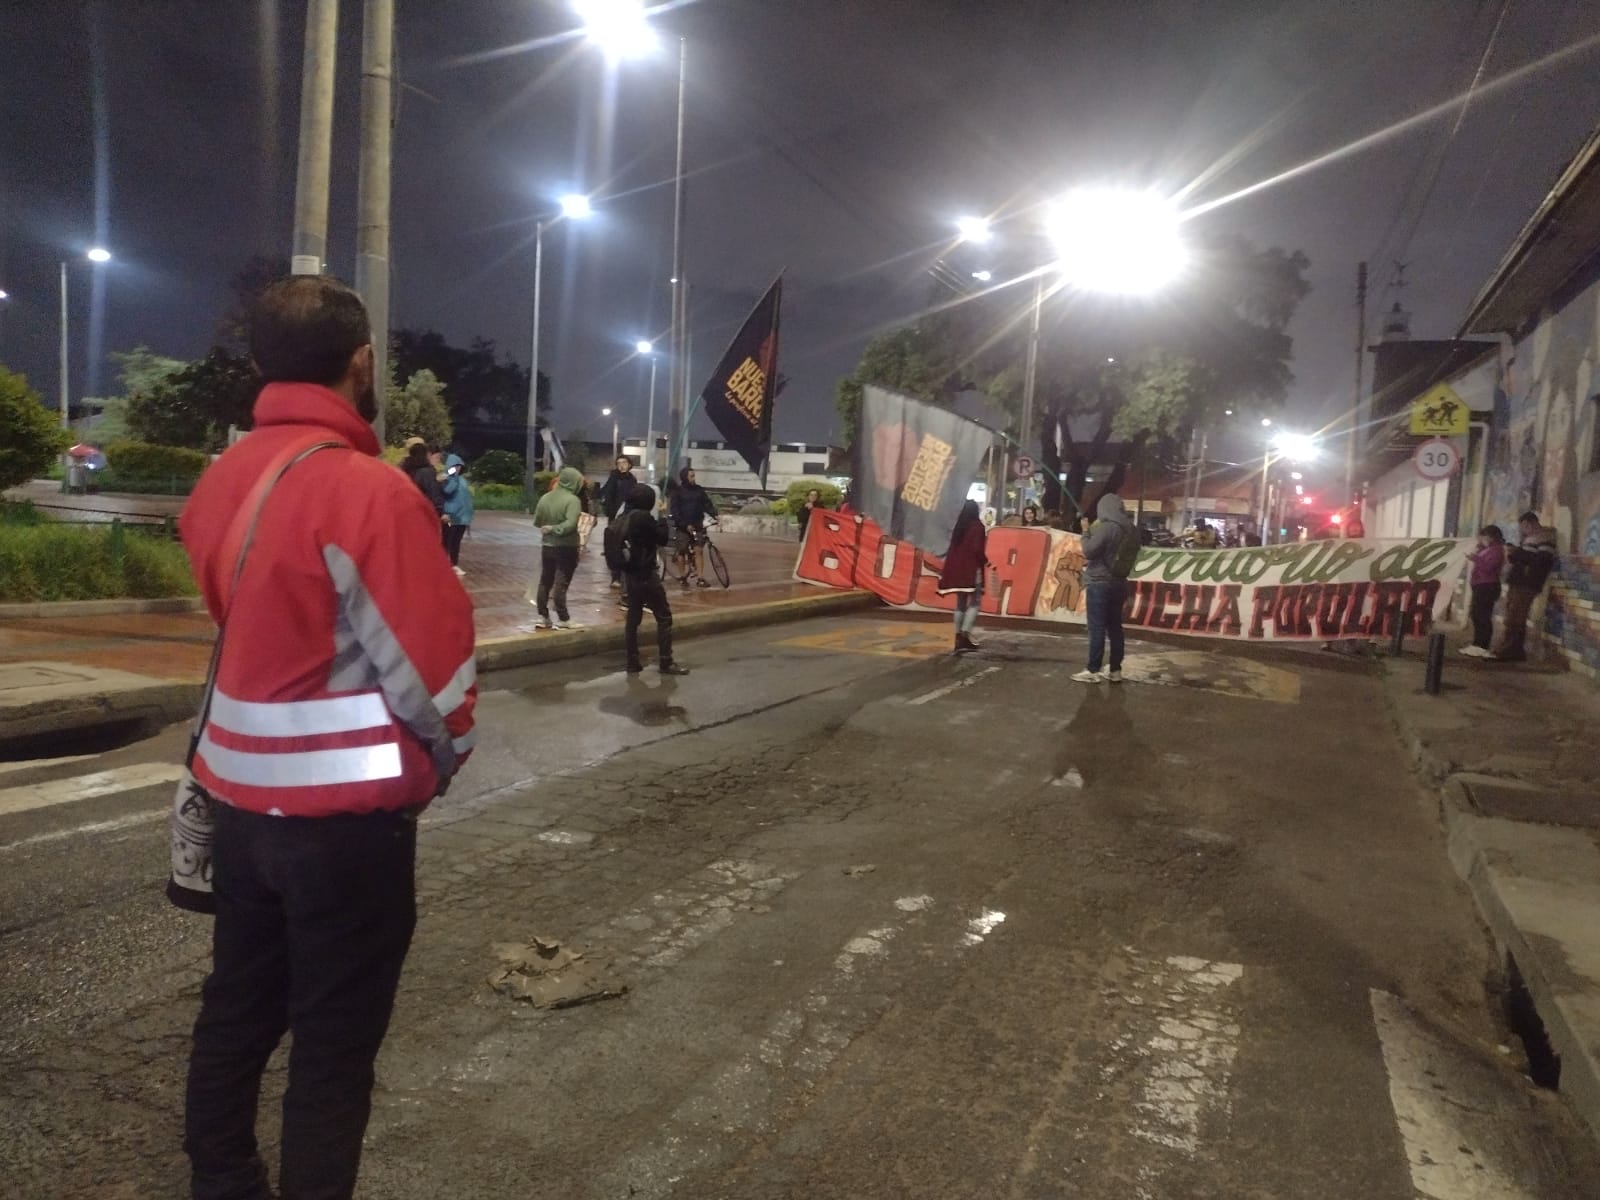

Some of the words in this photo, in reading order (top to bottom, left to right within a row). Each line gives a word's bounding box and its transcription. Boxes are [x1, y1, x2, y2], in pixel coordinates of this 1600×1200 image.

[1423, 452, 1449, 467] 30
[1127, 540, 1375, 584] erritorio
[1370, 538, 1456, 582] de
[1122, 580, 1242, 637] UCHA
[1249, 579, 1441, 638] POPULAR
